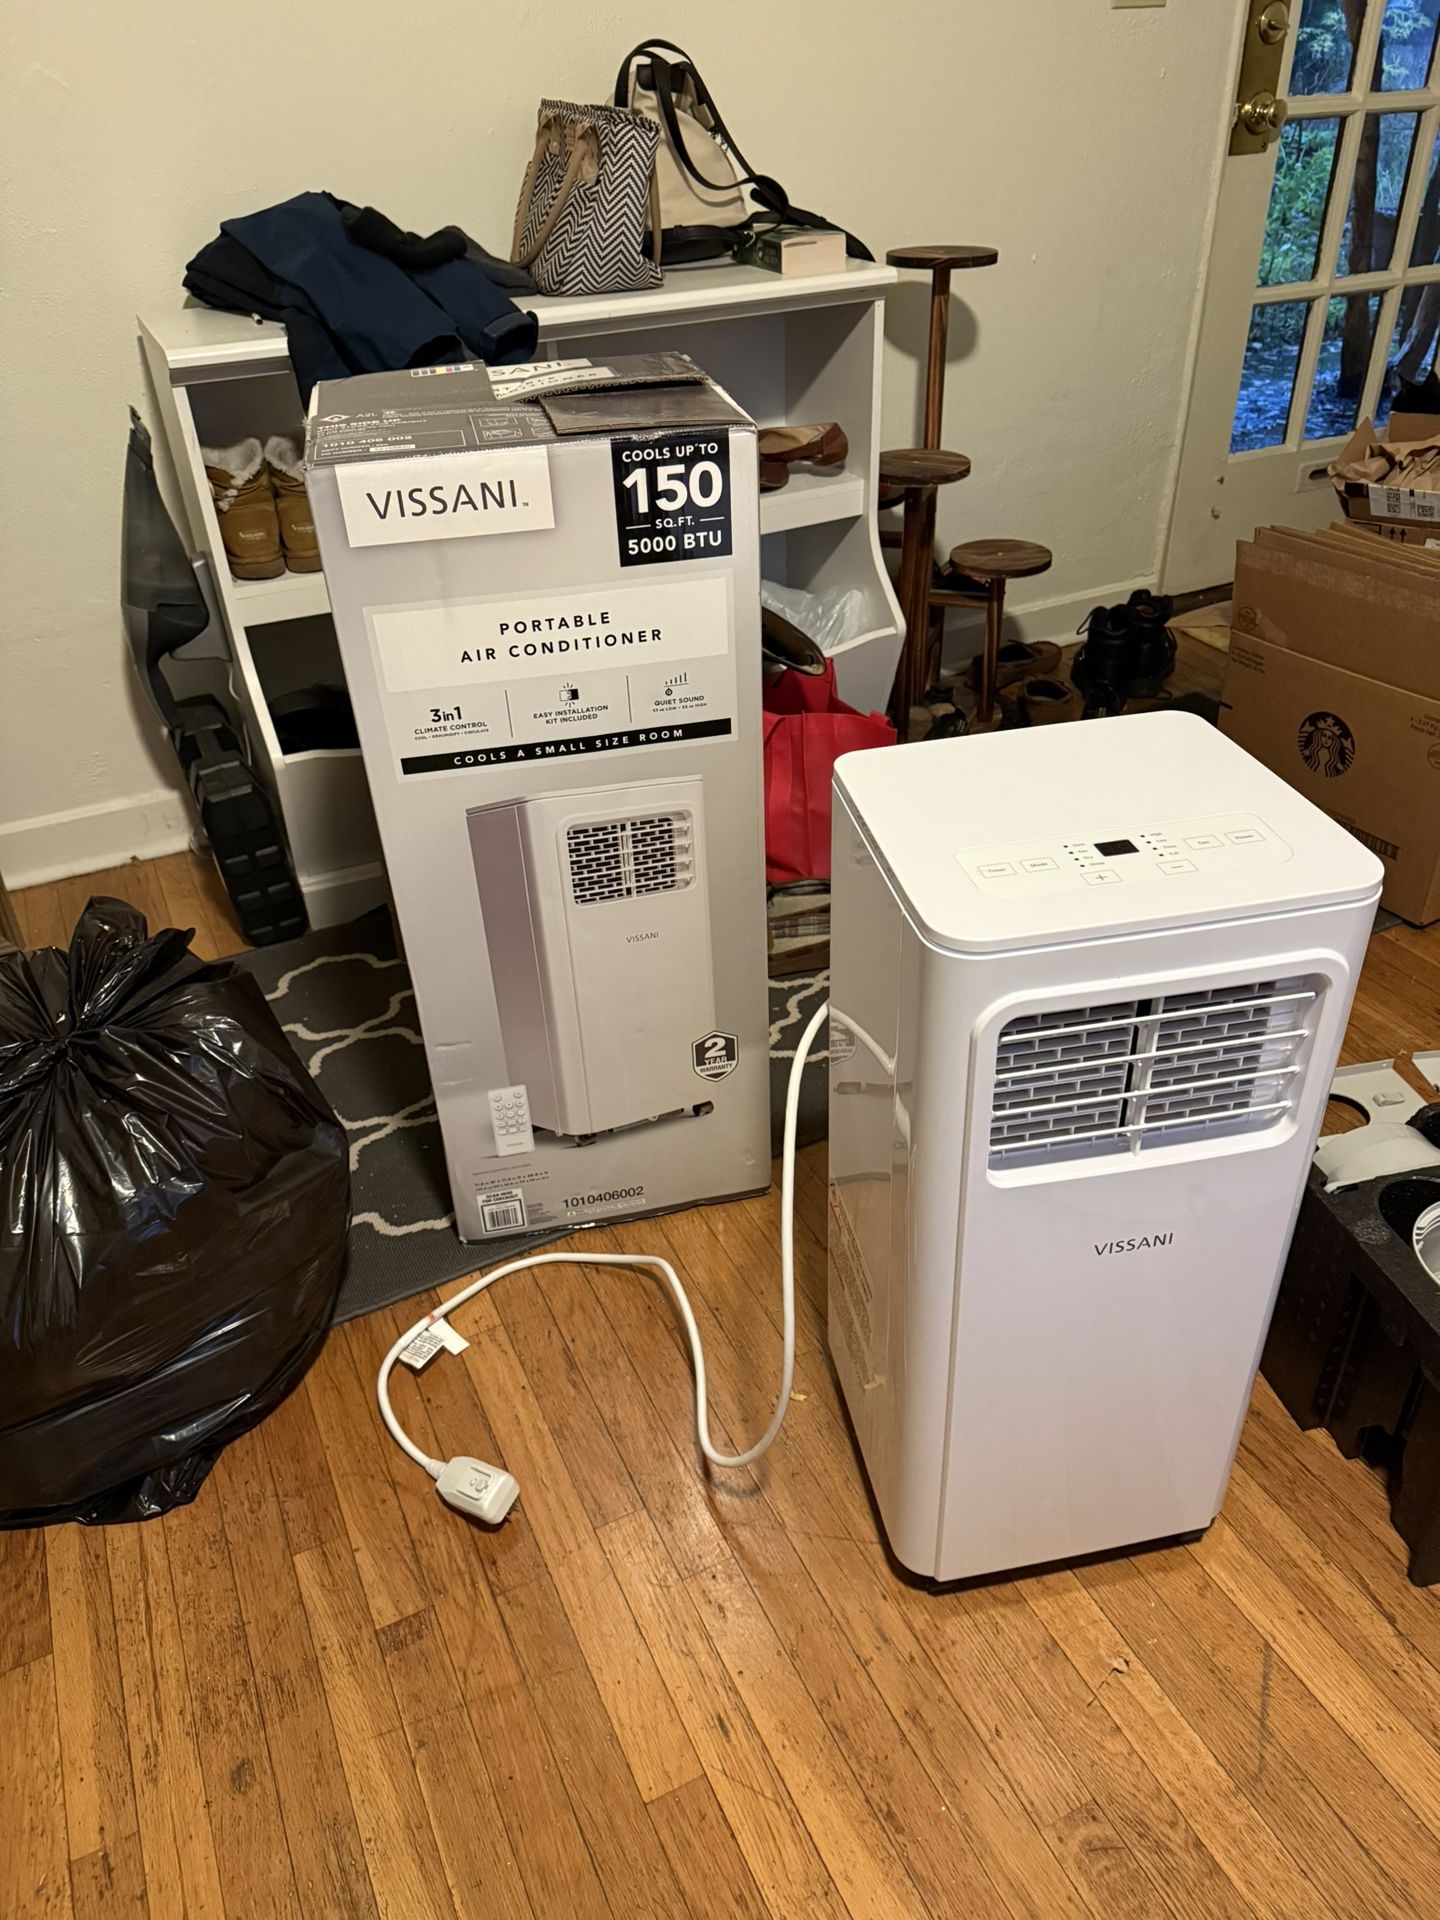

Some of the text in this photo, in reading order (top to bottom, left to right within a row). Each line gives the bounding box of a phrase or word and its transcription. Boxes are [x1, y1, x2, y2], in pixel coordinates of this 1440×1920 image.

[622, 442, 719, 463] COOLS UP TO
[622, 460, 723, 514] 150
[628, 529, 722, 555] 5000 BTU
[499, 611, 612, 636] PORTABLE
[460, 628, 664, 664] AIR CONDITIONER
[533, 704, 609, 719] EASY INSTALLATION
[654, 695, 705, 707] QUIET SOUND
[430, 706, 463, 723] 3in1
[545, 713, 598, 725] KIT INCLUDED
[414, 721, 488, 735] CLIMATE CONTROL
[453, 728, 684, 766] COOLS A SMALL SIZE ROOM
[626, 931, 660, 944] VISSANI
[704, 1037, 726, 1059] 2
[699, 1062, 734, 1073] WARRANTY
[704, 1056, 727, 1066] YEAR
[563, 1185, 645, 1208] 1010406002
[1094, 1232, 1174, 1257] VISSANI
